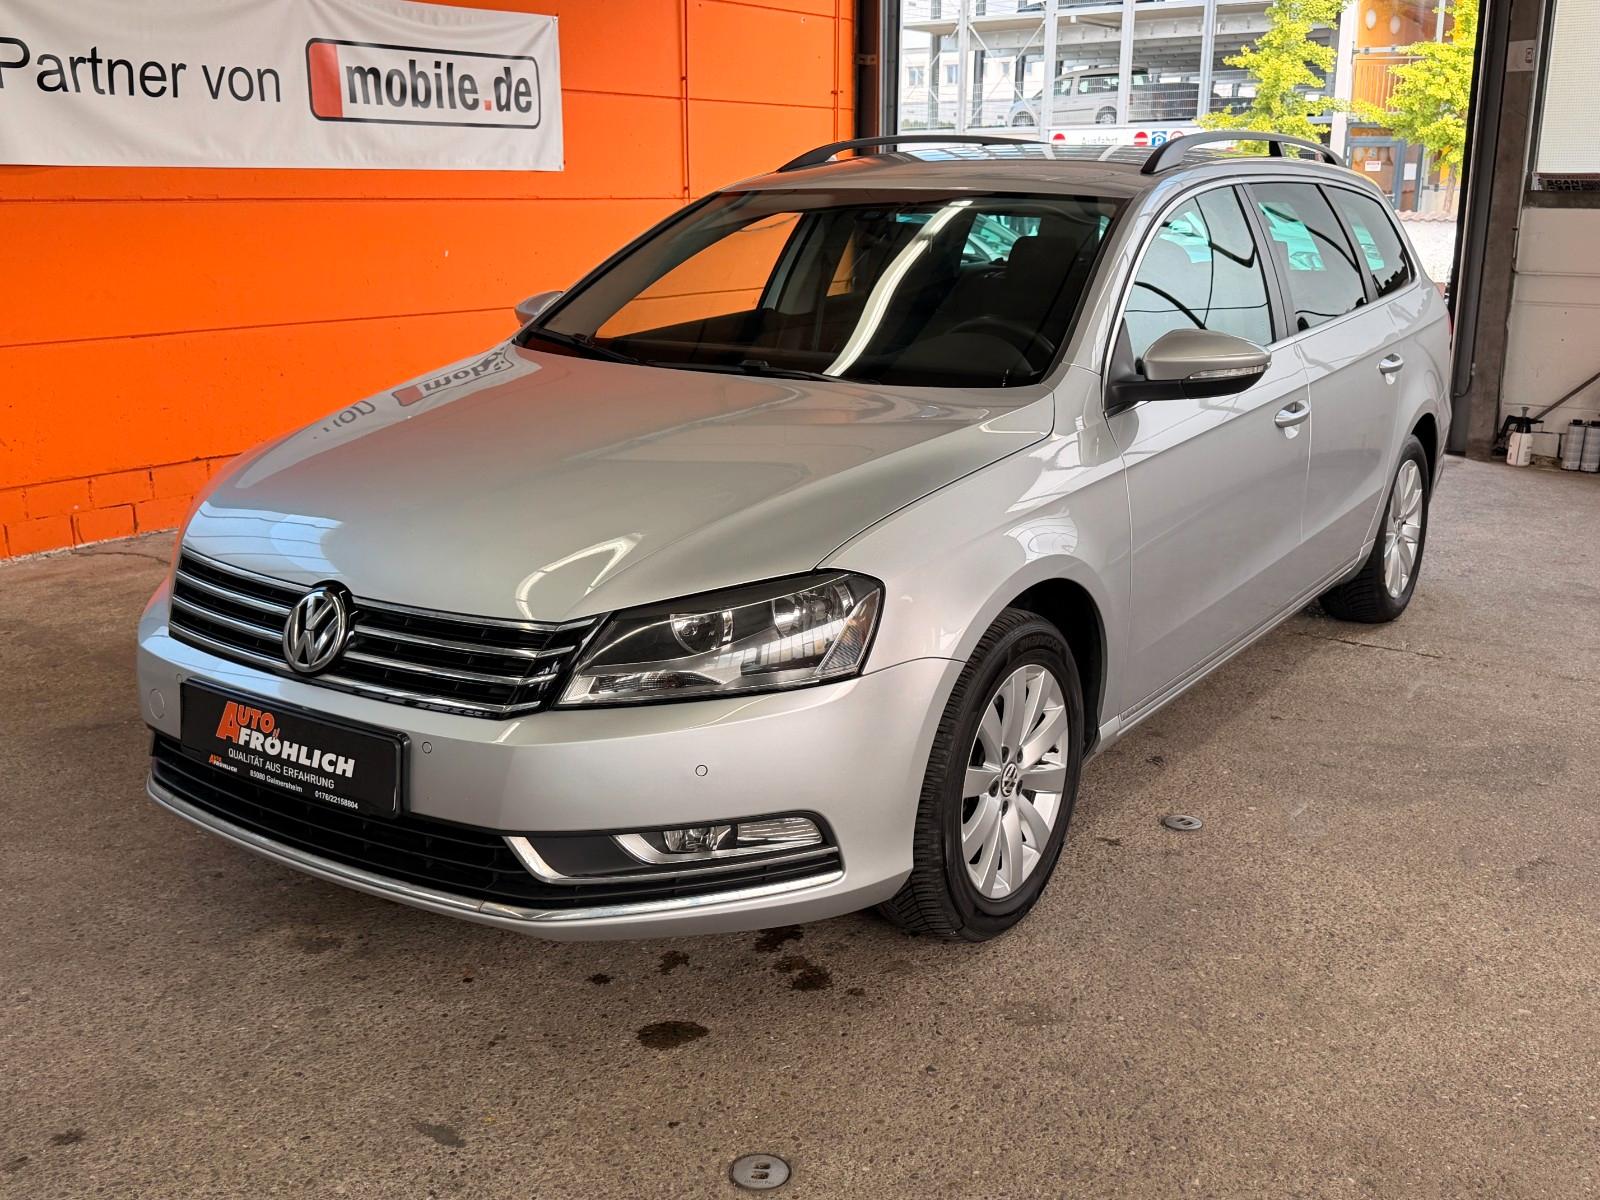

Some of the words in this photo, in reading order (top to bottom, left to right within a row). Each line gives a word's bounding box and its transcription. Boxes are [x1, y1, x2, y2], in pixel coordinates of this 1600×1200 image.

[0, 37, 187, 99] Partner
[202, 64, 281, 102] von
[345, 59, 533, 114] mobile.de
[228, 748, 264, 772] QUALITÄT
[265, 761, 281, 774] AUS
[283, 766, 335, 789] ERFAHRUNG
[238, 728, 355, 778] FRÖHLICH
